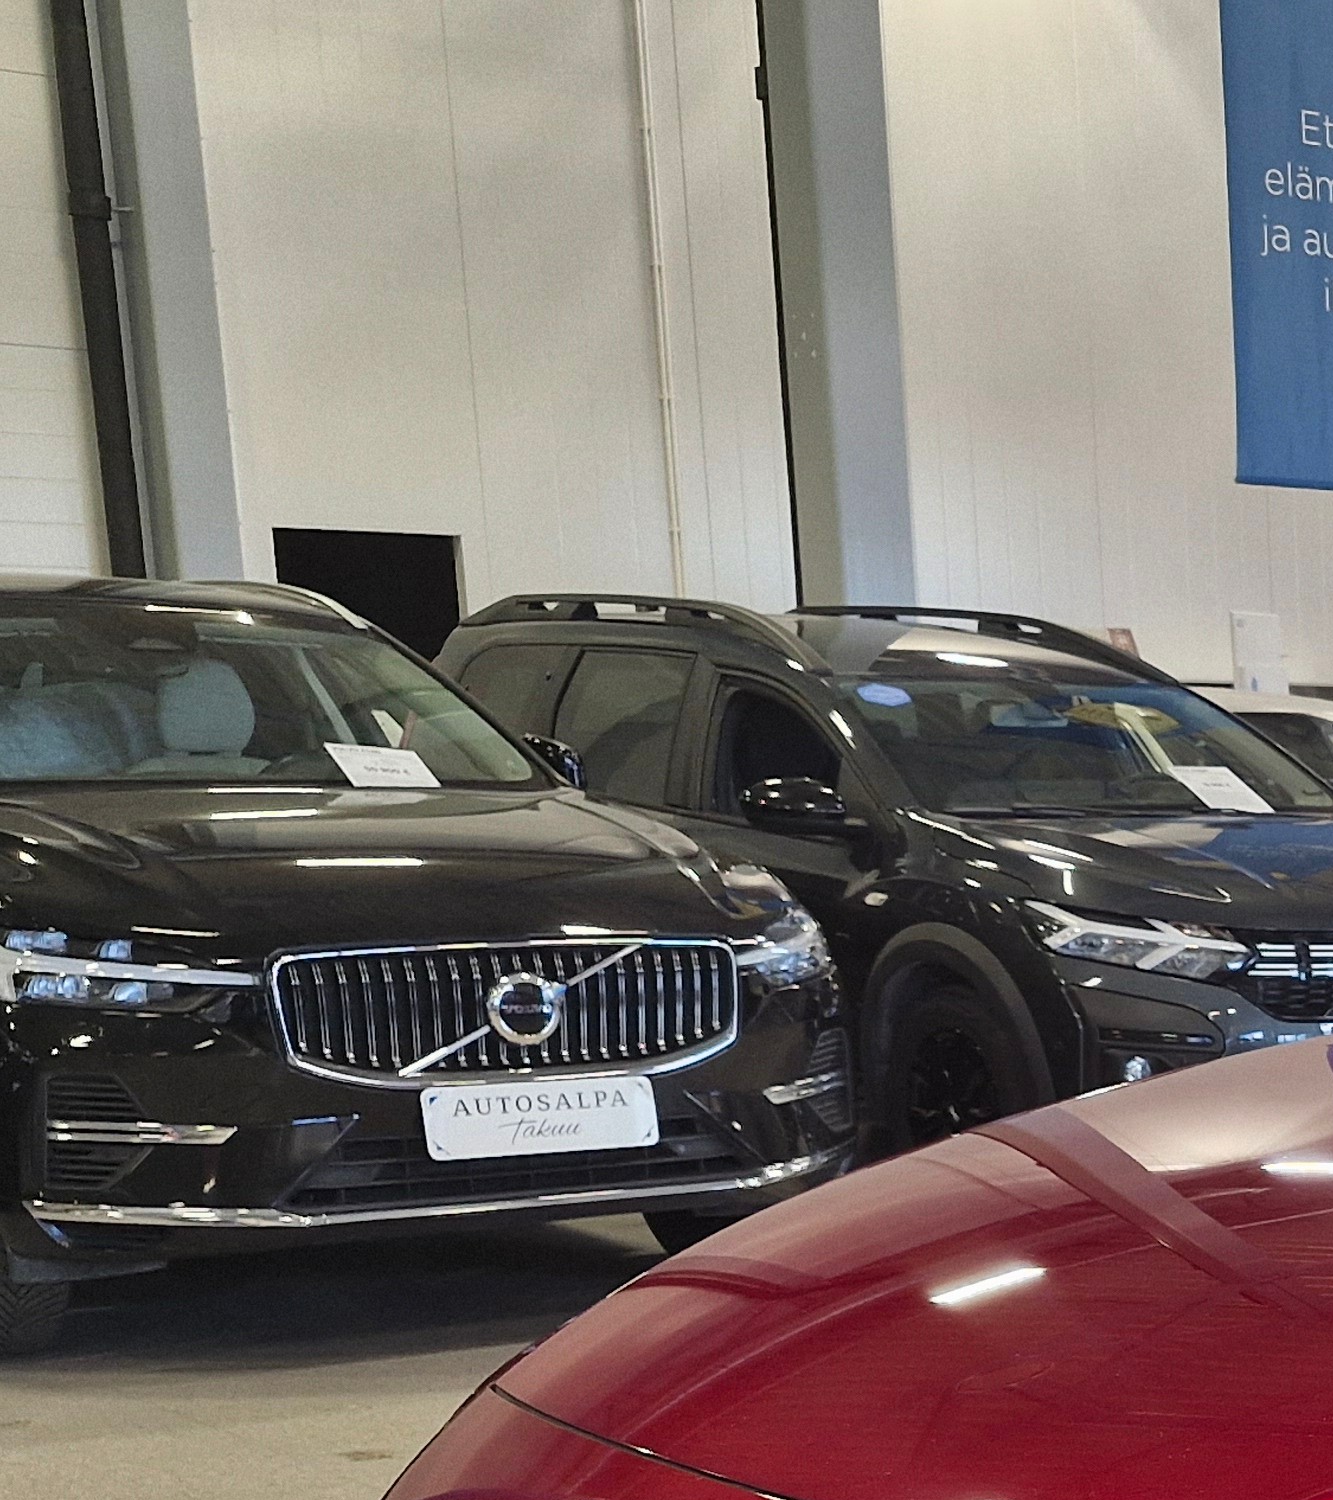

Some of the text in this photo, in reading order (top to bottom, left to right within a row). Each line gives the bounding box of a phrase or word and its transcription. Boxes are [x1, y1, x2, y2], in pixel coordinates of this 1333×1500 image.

[1261, 214, 1291, 256] ja
[453, 1088, 629, 1118] AUTOSALPA
[498, 1117, 583, 1145] Takuu
